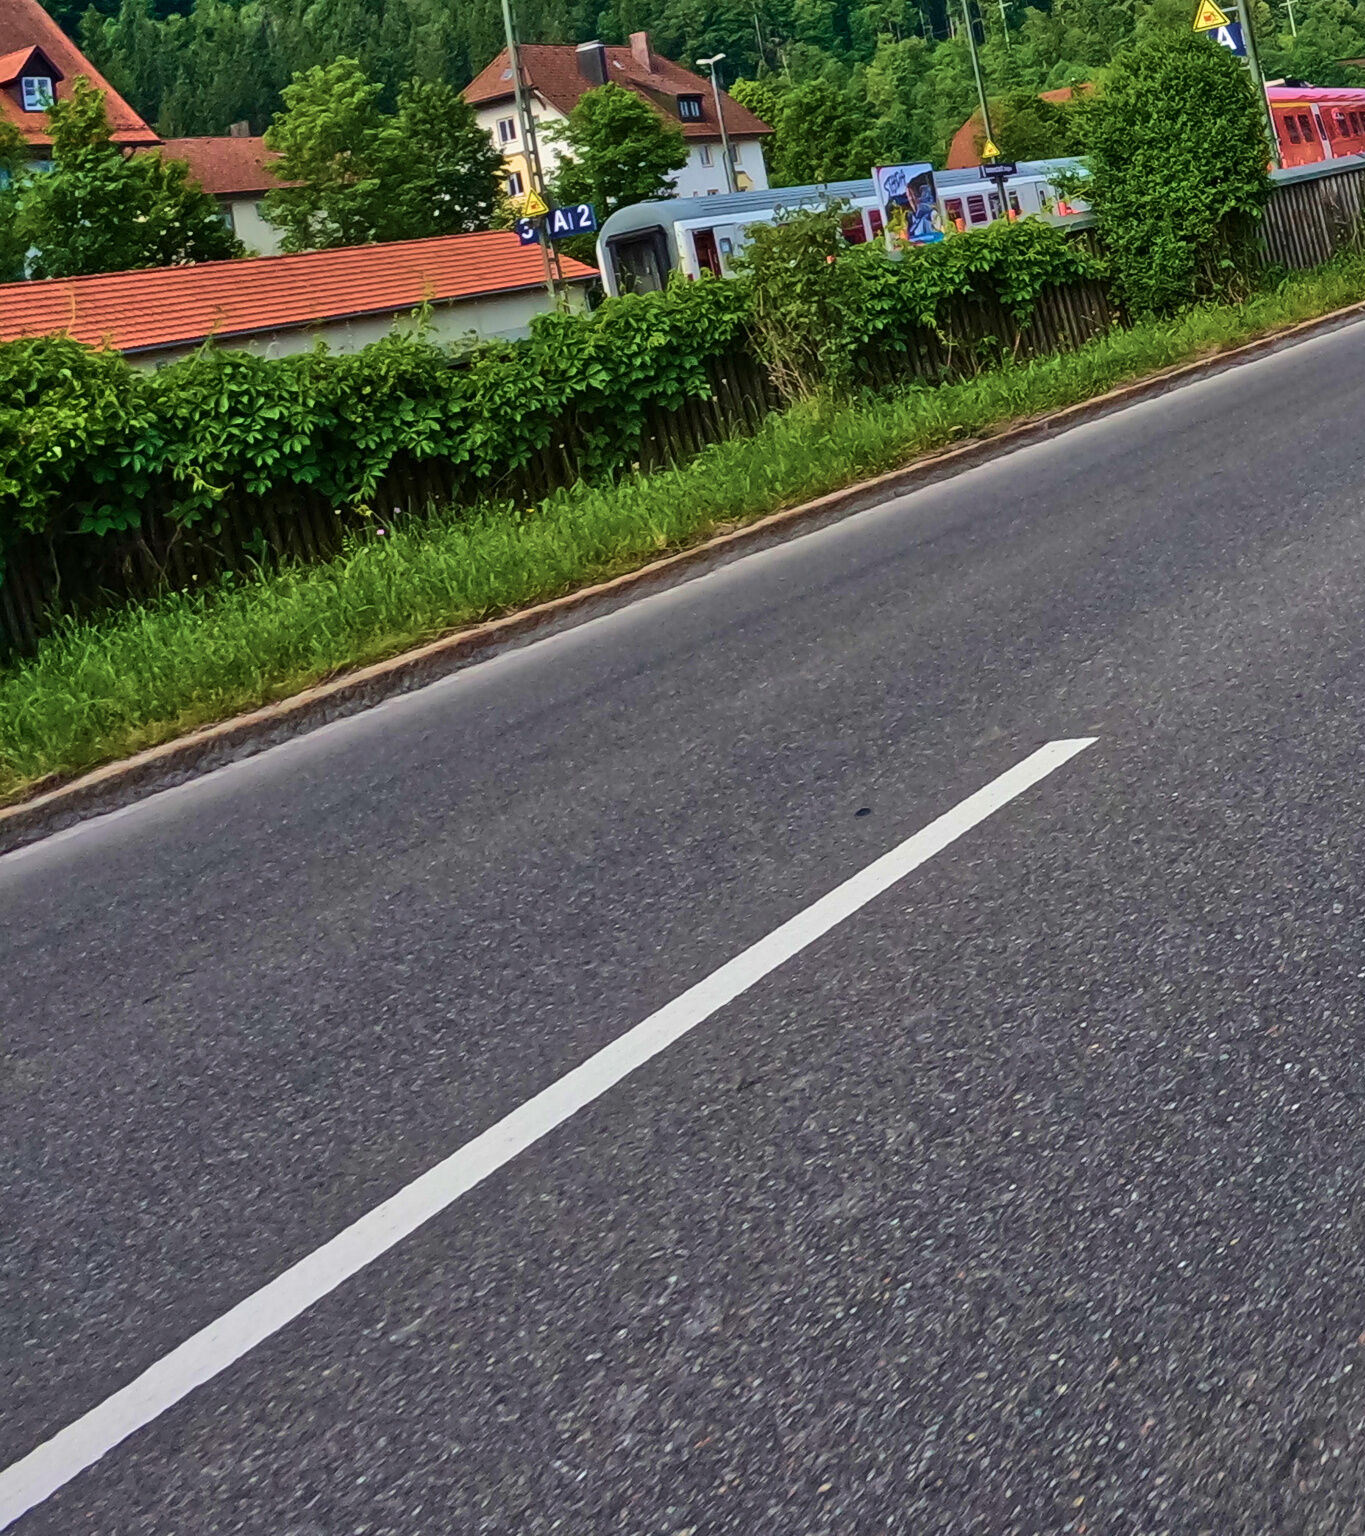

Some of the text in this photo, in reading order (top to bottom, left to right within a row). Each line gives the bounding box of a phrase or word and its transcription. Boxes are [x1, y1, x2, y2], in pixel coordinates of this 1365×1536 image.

[1217, 26, 1237, 50] A
[554, 210, 569, 233] A
[577, 204, 592, 228] 2
